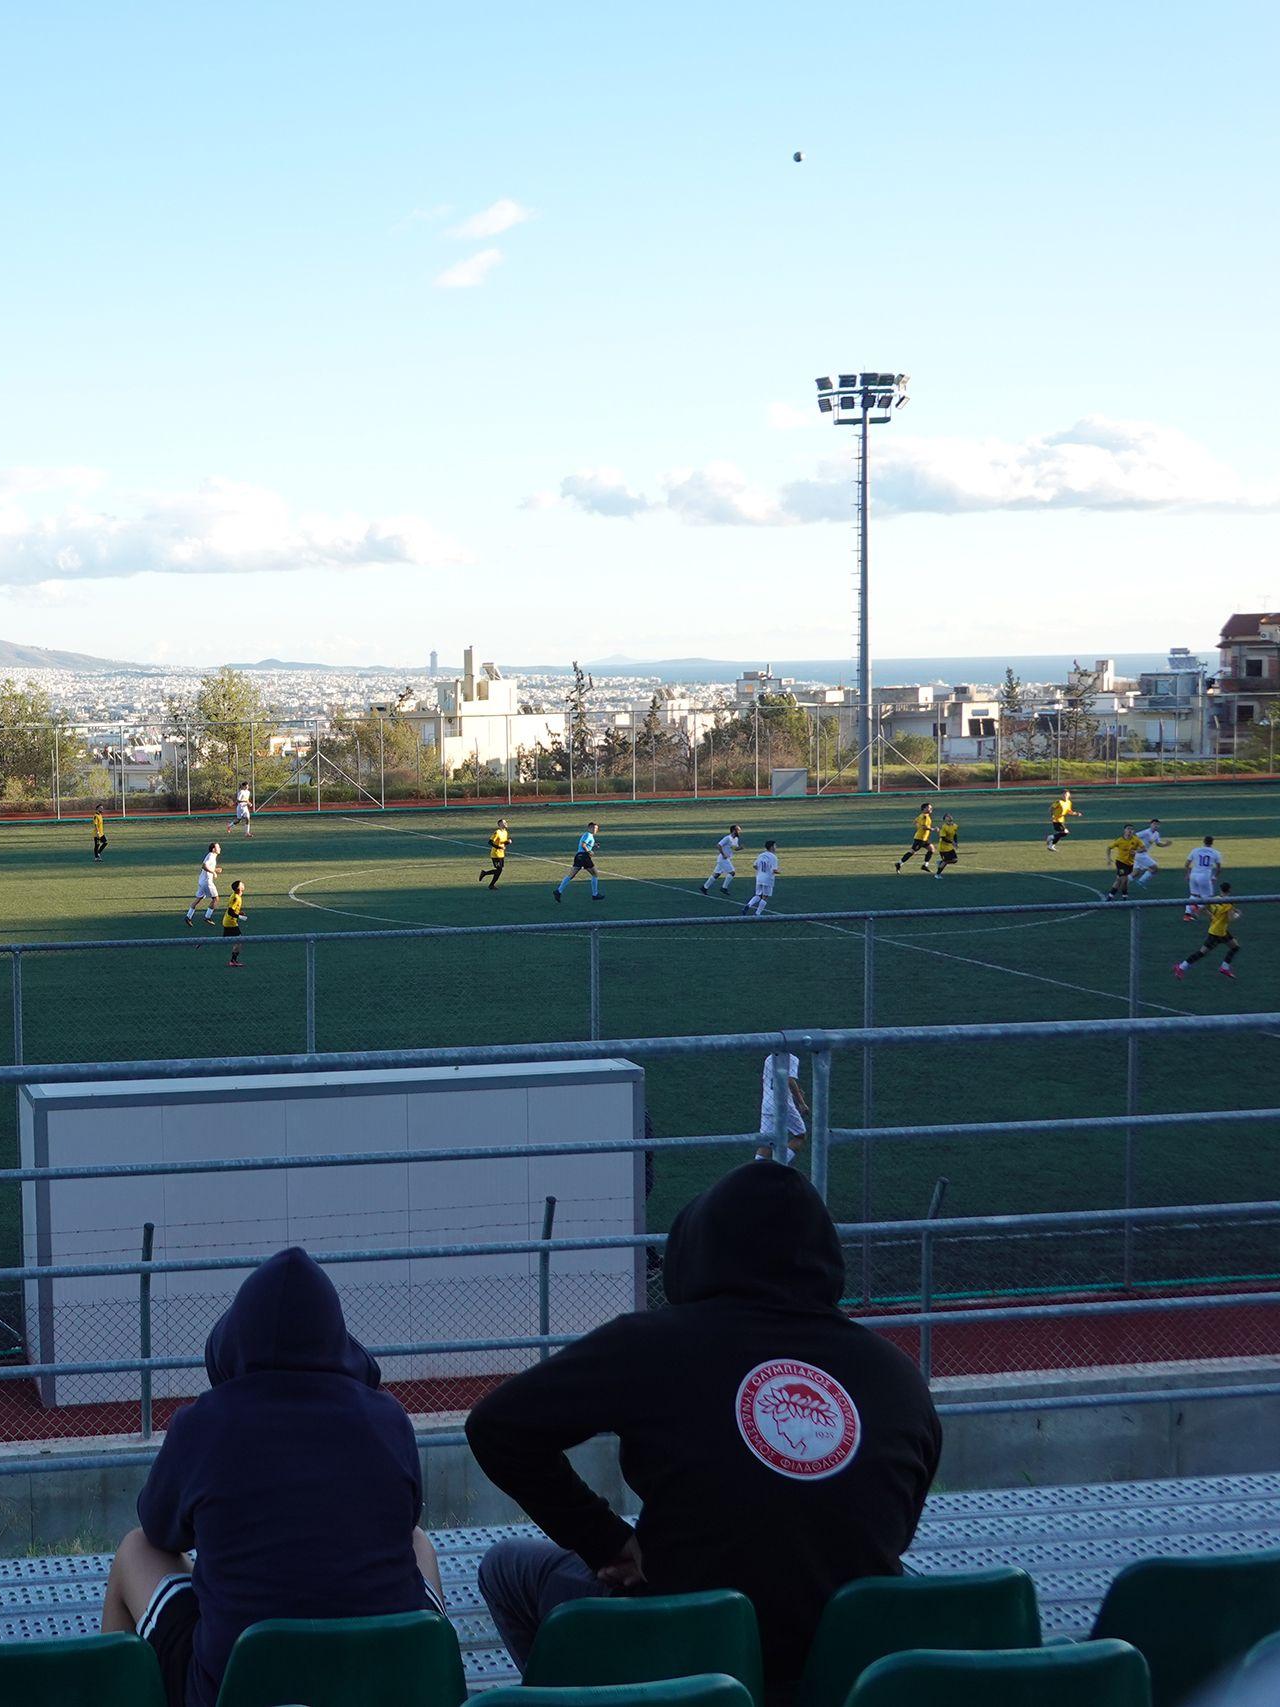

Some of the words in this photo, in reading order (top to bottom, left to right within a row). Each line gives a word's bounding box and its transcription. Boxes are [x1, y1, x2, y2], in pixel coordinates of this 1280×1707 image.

[1198, 855, 1210, 867] 10
[752, 1364, 832, 1389] ΟΛΥΜΠΙΑΚΟΣ
[780, 1450, 846, 1472] ΦΙΛΑΘΛΩΝ
